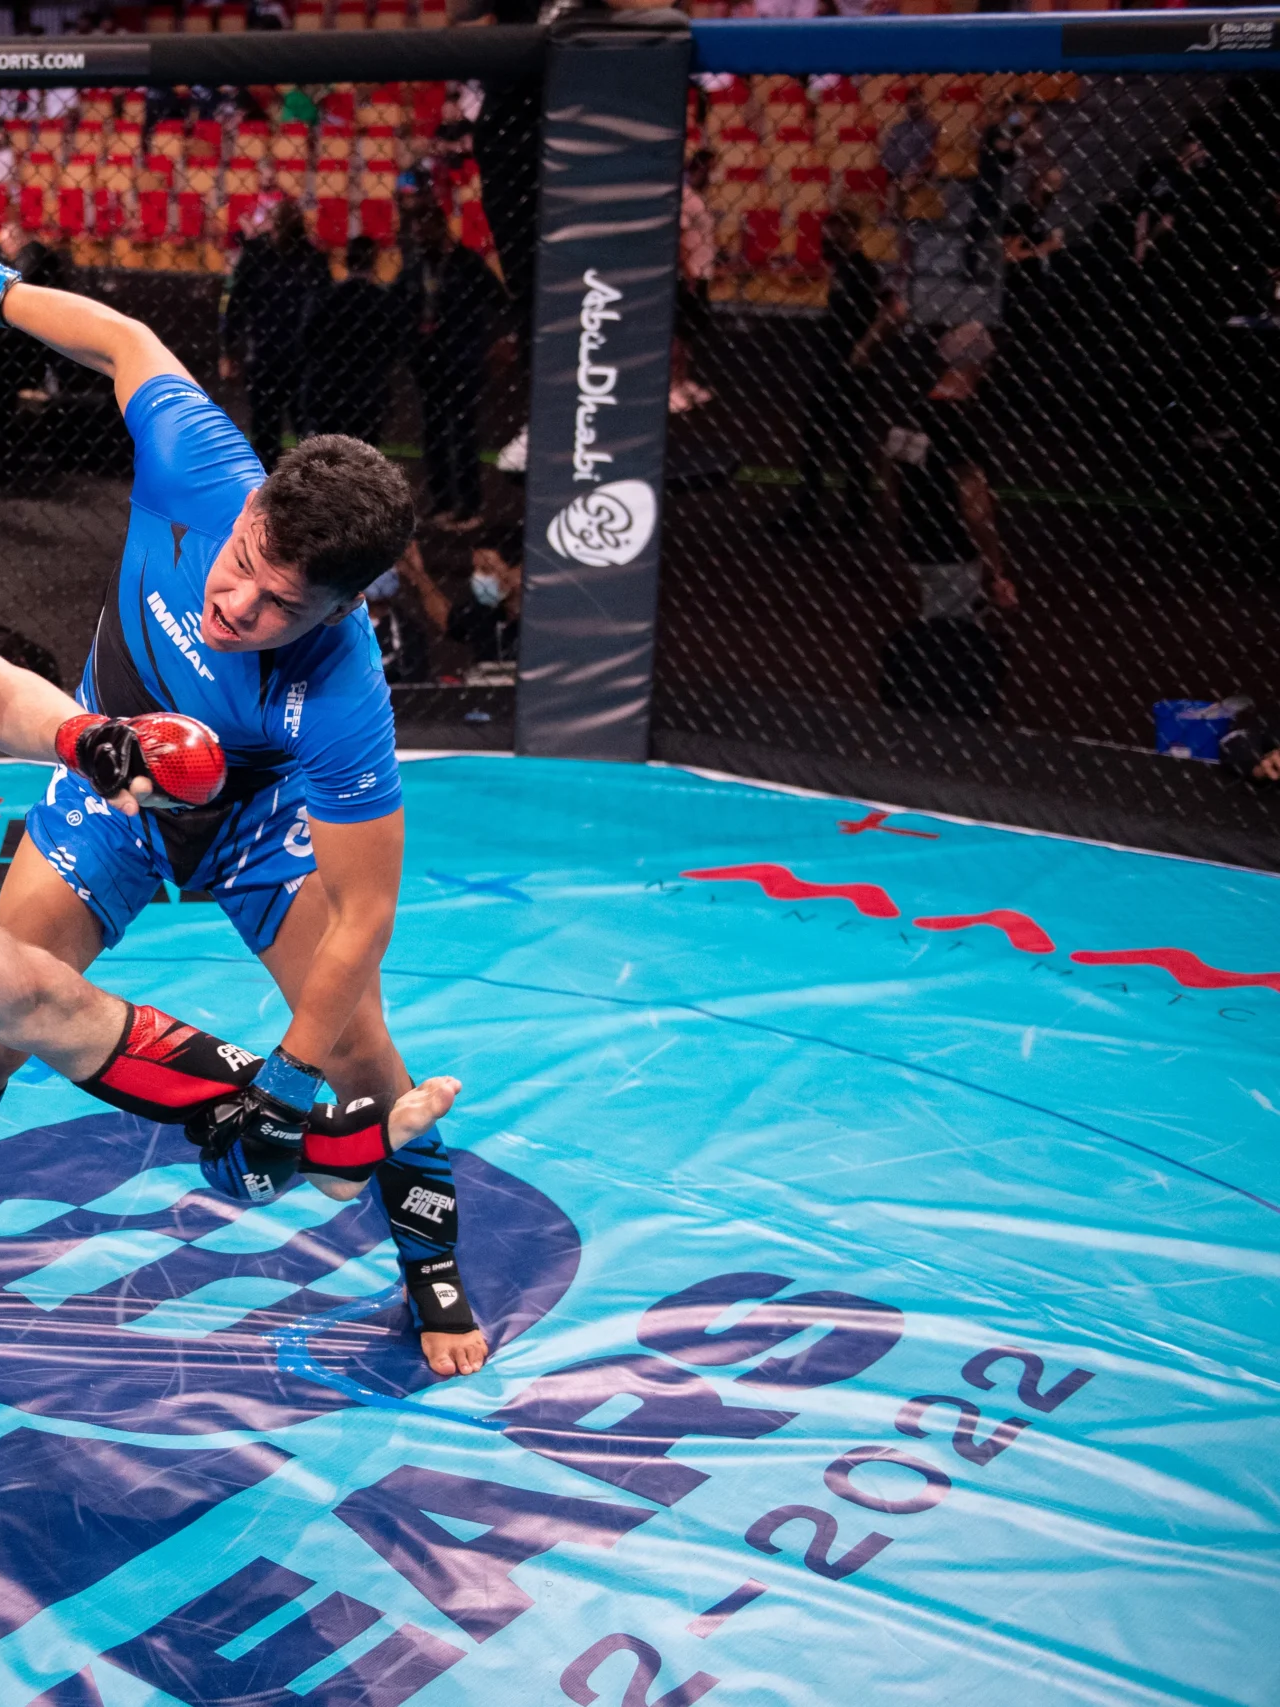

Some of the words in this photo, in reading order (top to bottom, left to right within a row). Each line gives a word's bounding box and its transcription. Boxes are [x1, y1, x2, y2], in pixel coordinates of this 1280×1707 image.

[146, 590, 216, 682] IMMAF
[400, 1195, 444, 1225] HILL
[408, 1185, 456, 1212] GREEN
[25, 1270, 906, 1707] EARS
[743, 1344, 1098, 1582] 2022
